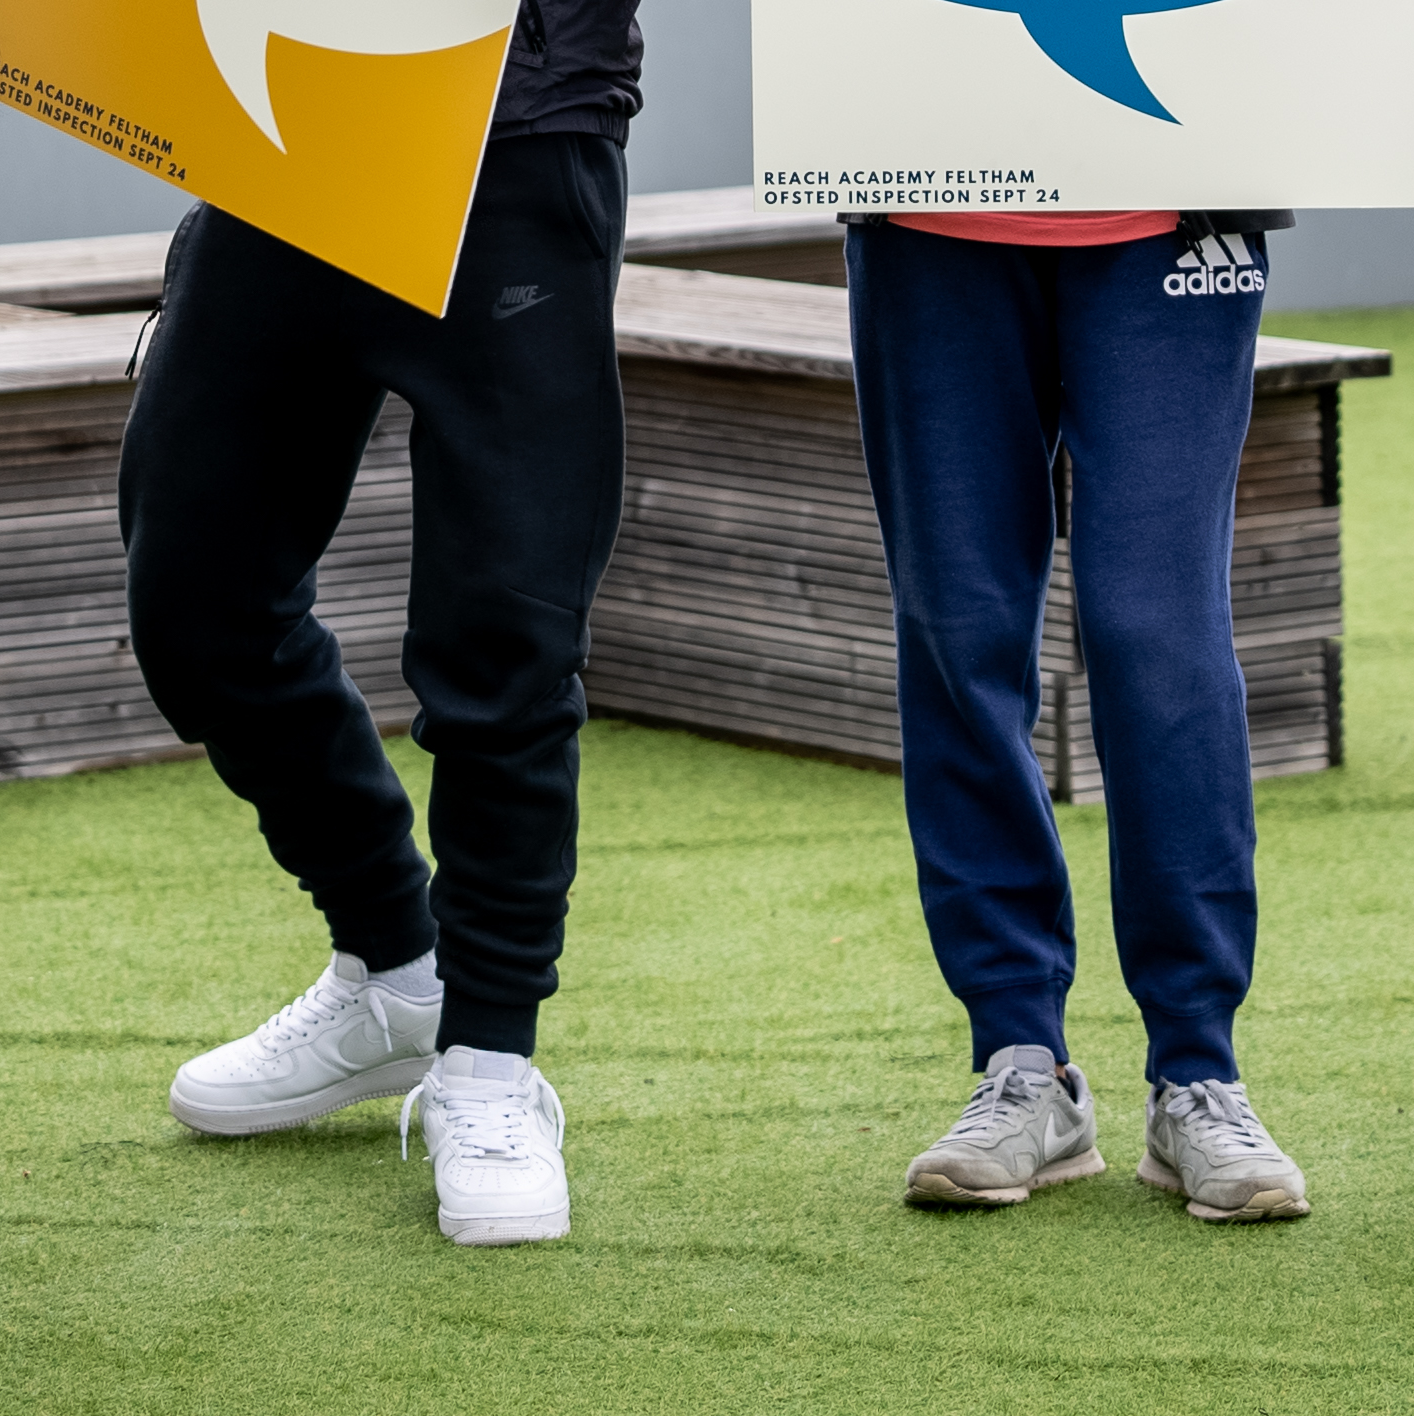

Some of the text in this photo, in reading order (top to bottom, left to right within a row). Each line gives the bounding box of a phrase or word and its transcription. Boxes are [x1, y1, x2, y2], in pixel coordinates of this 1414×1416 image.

[34, 79, 105, 121] ACADEMY
[108, 113, 173, 156] FELTHAM
[37, 99, 124, 151] INSPECTION
[128, 143, 164, 170] SEPT
[167, 162, 186, 181] 24
[764, 169, 1035, 186] REACH ACADEMY FELTHAM
[764, 188, 1060, 205] OFSTED INSPECTION SEPT 24
[1163, 263, 1265, 296] adidas
[499, 285, 539, 304] NIKE
